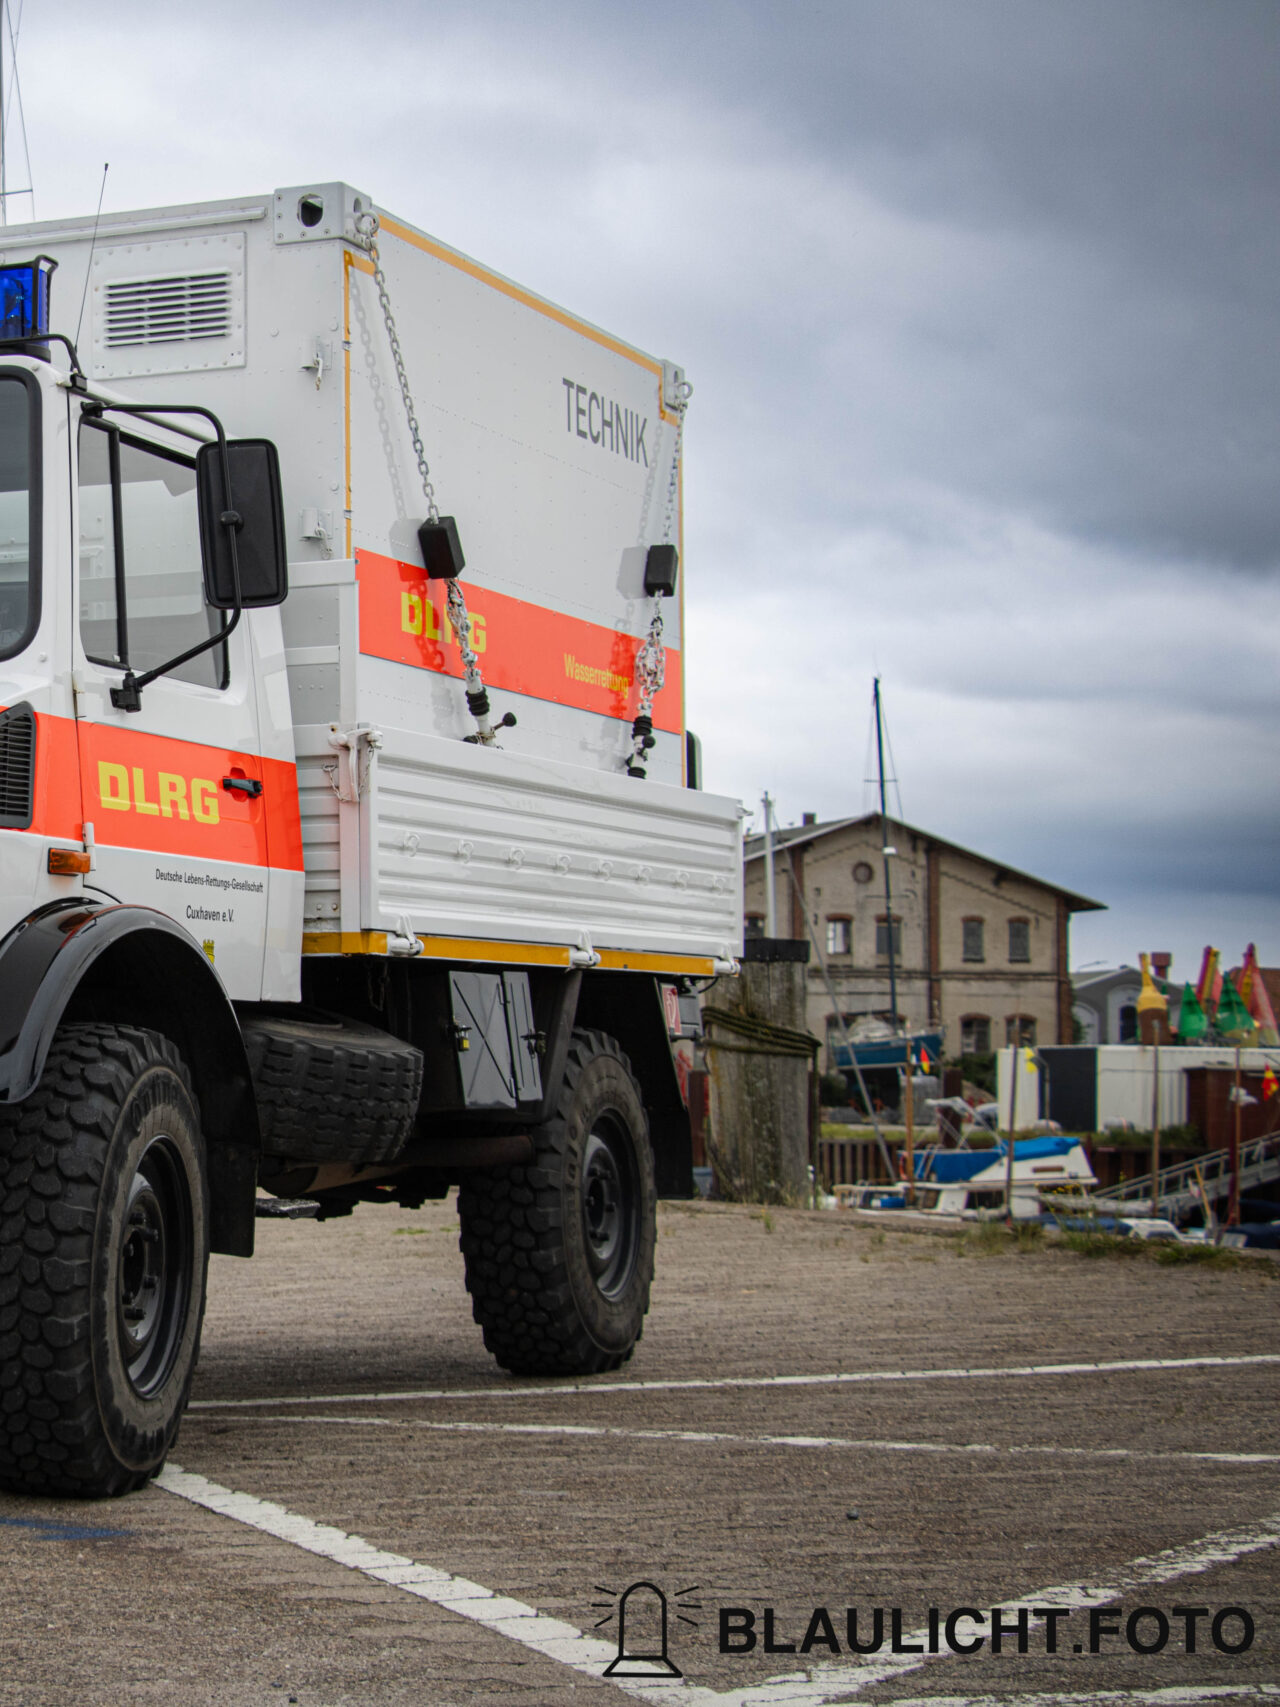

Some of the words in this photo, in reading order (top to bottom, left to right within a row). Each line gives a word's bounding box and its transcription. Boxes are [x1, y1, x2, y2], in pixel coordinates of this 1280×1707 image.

[562, 377, 648, 468] TECHNIK
[563, 652, 628, 699] Wasserrettung
[98, 760, 220, 825] DLRG
[155, 868, 183, 883] Deutsche
[186, 905, 220, 921] Cuxhaven
[222, 909, 235, 923] e.V.
